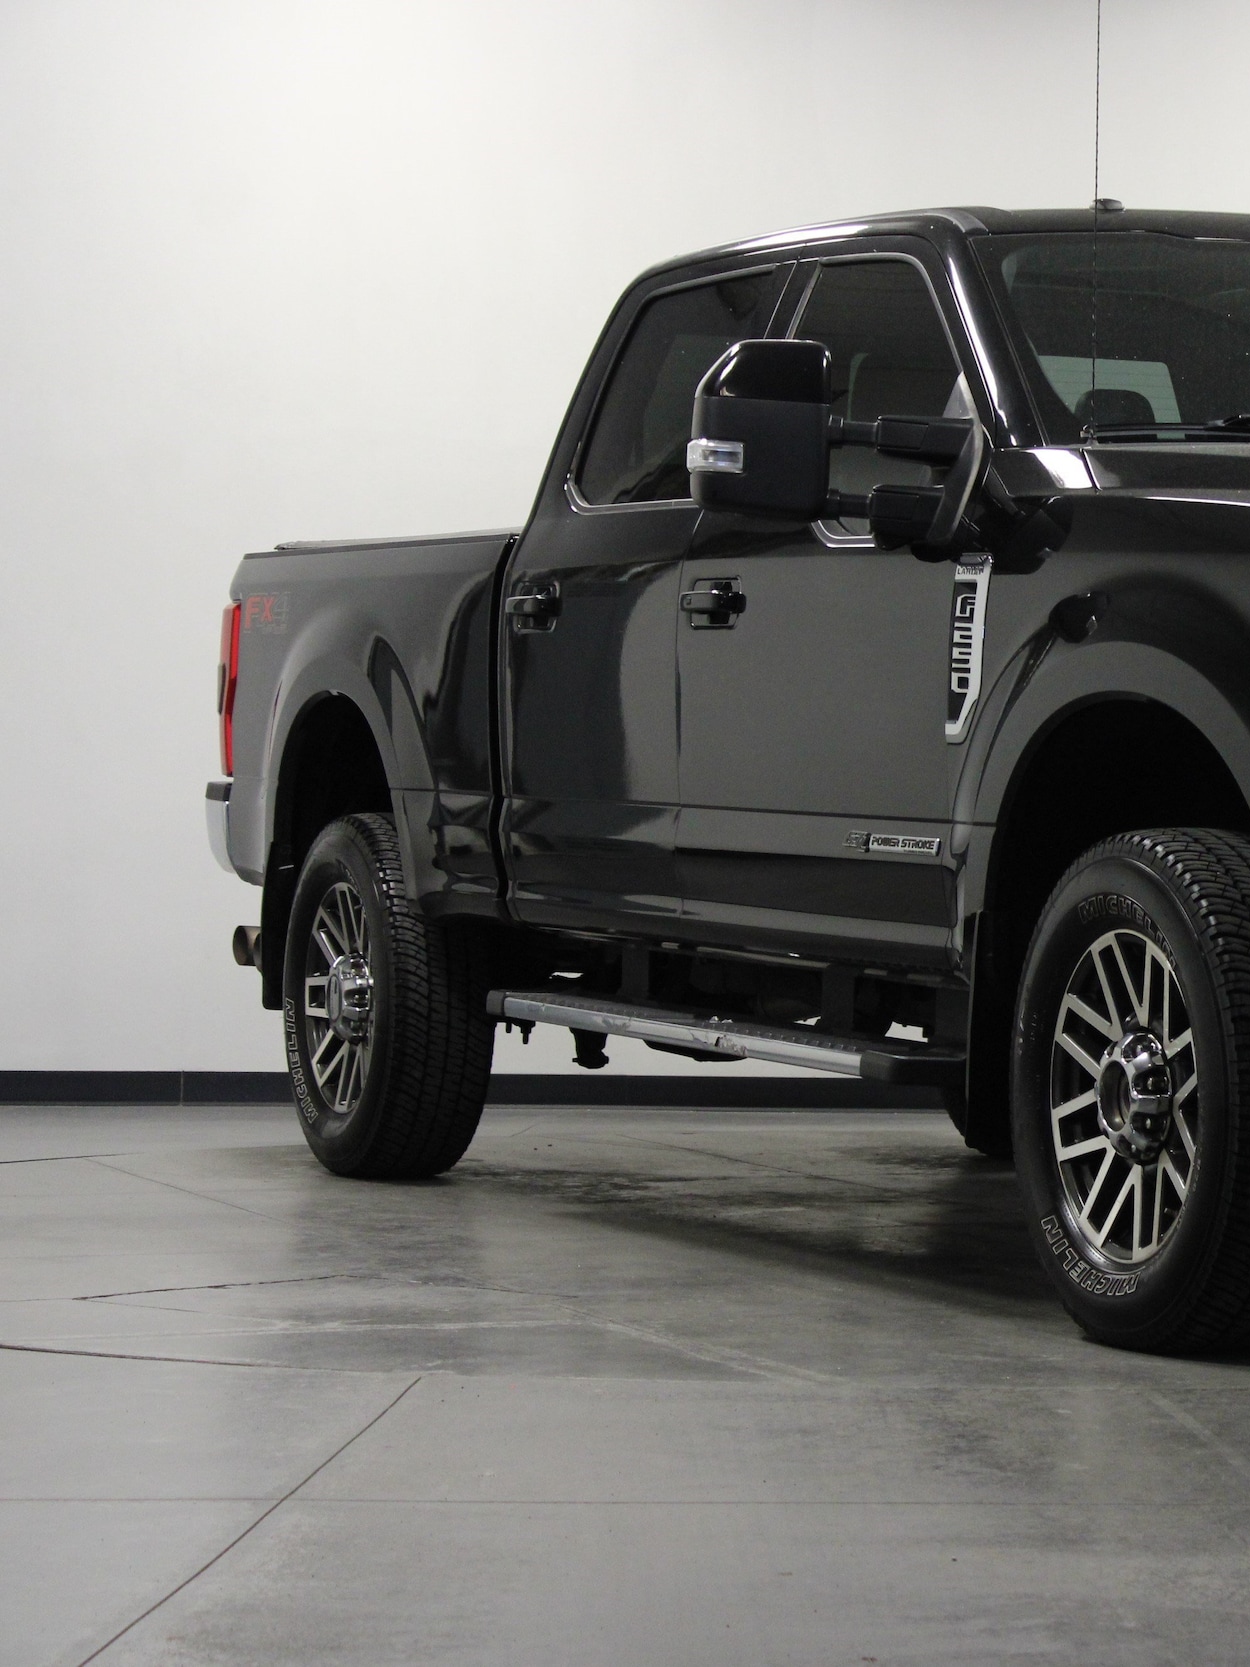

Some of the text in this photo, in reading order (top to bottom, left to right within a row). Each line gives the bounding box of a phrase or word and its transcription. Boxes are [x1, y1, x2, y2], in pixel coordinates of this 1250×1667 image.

[871, 836, 900, 848] POWER
[900, 838, 935, 850] STROKE
[1078, 895, 1177, 969] MICHELIN
[285, 997, 319, 1124] MICHELIN
[1040, 1215, 1142, 1297] MICHELIN
